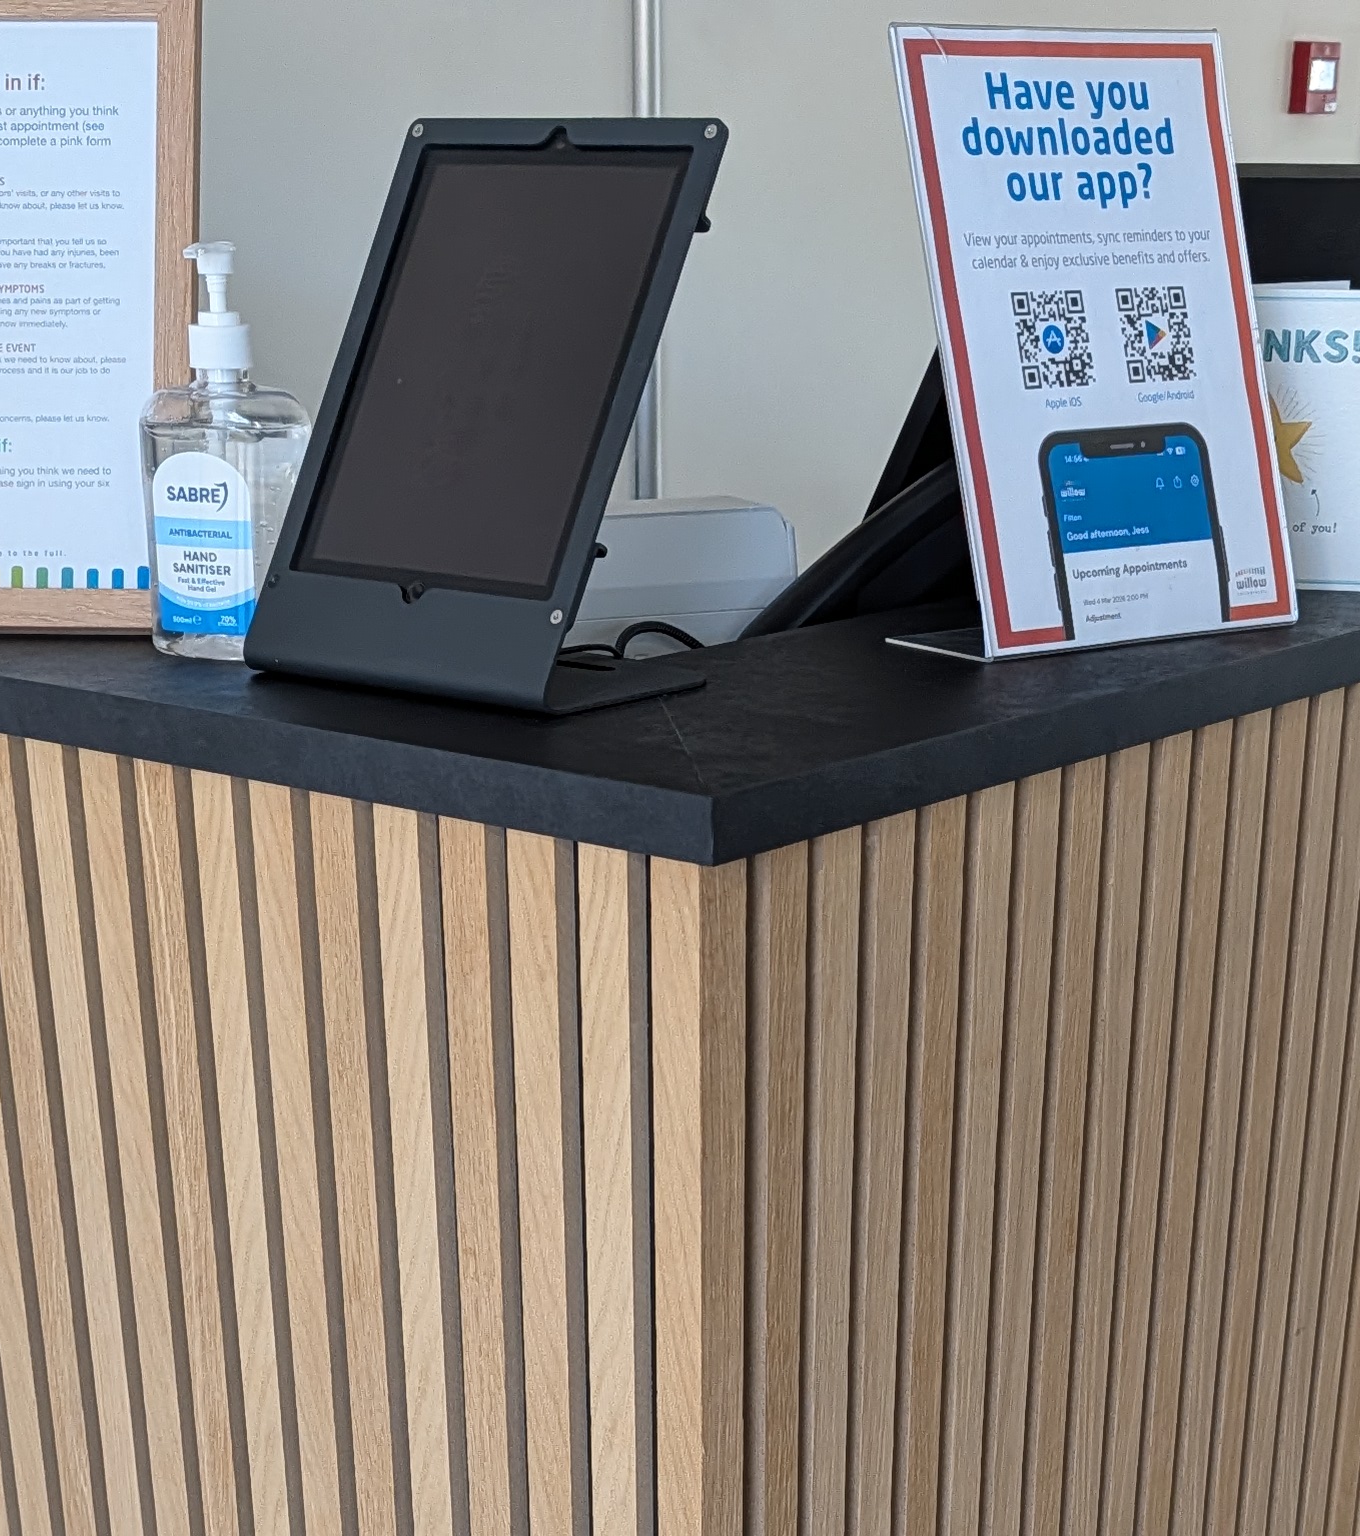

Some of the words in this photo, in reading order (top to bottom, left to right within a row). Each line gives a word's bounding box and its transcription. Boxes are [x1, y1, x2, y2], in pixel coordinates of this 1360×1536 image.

[5, 73, 21, 91] in
[28, 73, 45, 91] if:
[985, 72, 1075, 110] Have
[1088, 80, 1150, 119] you
[5, 107, 17, 116] or
[19, 105, 66, 119] anything
[69, 107, 89, 119] you
[92, 106, 119, 116] think
[10, 121, 79, 133] appointment
[82, 120, 105, 133] (see
[50, 138, 57, 146] a
[60, 136, 83, 148] pink
[86, 135, 111, 146] form
[962, 117, 1175, 156] downloaded
[1007, 172, 1063, 202] our
[1077, 162, 1152, 209] app?
[963, 232, 992, 247] View
[993, 234, 1018, 249] your
[1021, 230, 1095, 248] appointments,
[1097, 232, 1121, 247] sync
[1122, 228, 1173, 243] reminders
[1175, 229, 1186, 242] to
[1188, 230, 1210, 244] your
[972, 254, 1018, 270] calendar
[1020, 254, 1029, 268] &
[1031, 253, 1060, 271] enjoy
[1062, 252, 1110, 267] exclusive
[1111, 250, 1155, 265] benefits
[1157, 250, 1176, 264] and
[1177, 249, 1211, 263] offers.
[6, 343, 36, 353] EVENT
[1045, 397, 1068, 411] Apple
[1069, 396, 1083, 407] iOS
[1138, 390, 1195, 404] Google/Android
[17, 468, 35, 477] you
[37, 466, 59, 475] think
[77, 467, 100, 476] need
[102, 467, 112, 475] to
[16, 480, 35, 490] sign
[37, 479, 46, 487] in
[48, 480, 73, 490] using
[74, 480, 95, 490] your
[97, 480, 110, 488] six
[167, 486, 221, 504] SABRE
[169, 528, 233, 539] ANTIBACTERIAL
[1066, 531, 1089, 542] Good
[1090, 528, 1131, 540] afternoon,
[1132, 526, 1150, 536] Jess
[1292, 522, 1307, 533] of
[1311, 522, 1337, 535] you!
[183, 551, 218, 563] HAND
[173, 563, 232, 577] SANITISER
[1072, 565, 1121, 582] Upcoming
[1123, 559, 1188, 576] Appointments
[177, 576, 190, 584] Fast
[197, 577, 226, 587] Effective
[1236, 576, 1267, 590] willow
[205, 585, 217, 593] Gel
